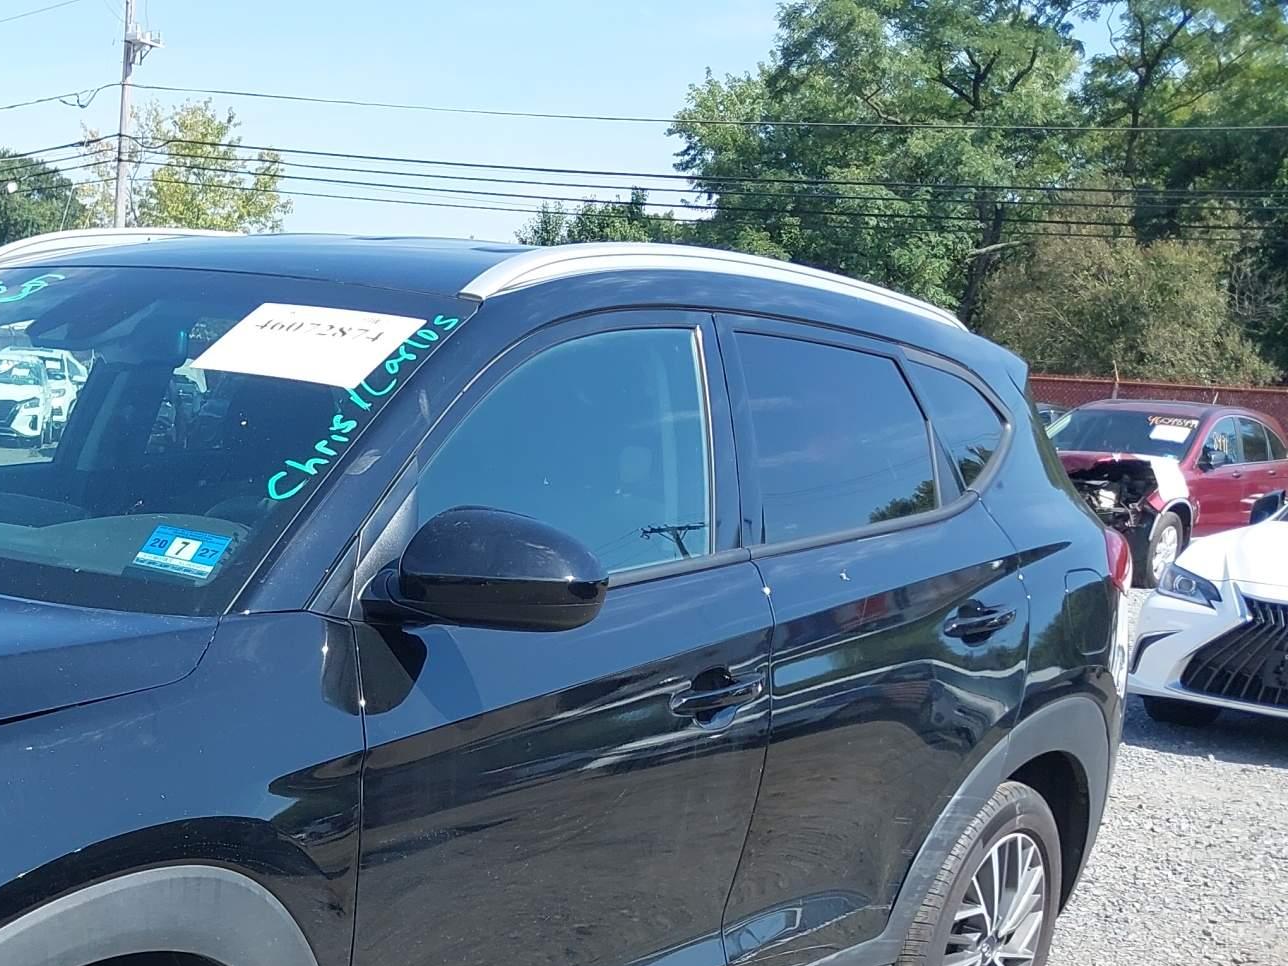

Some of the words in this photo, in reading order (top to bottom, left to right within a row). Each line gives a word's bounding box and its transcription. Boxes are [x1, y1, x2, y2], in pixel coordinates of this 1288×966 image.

[255, 319, 385, 342] 46072874
[267, 414, 358, 501] Chris
[151, 538, 168, 549] 20
[175, 541, 190, 556] 7
[198, 548, 219, 559] 27
